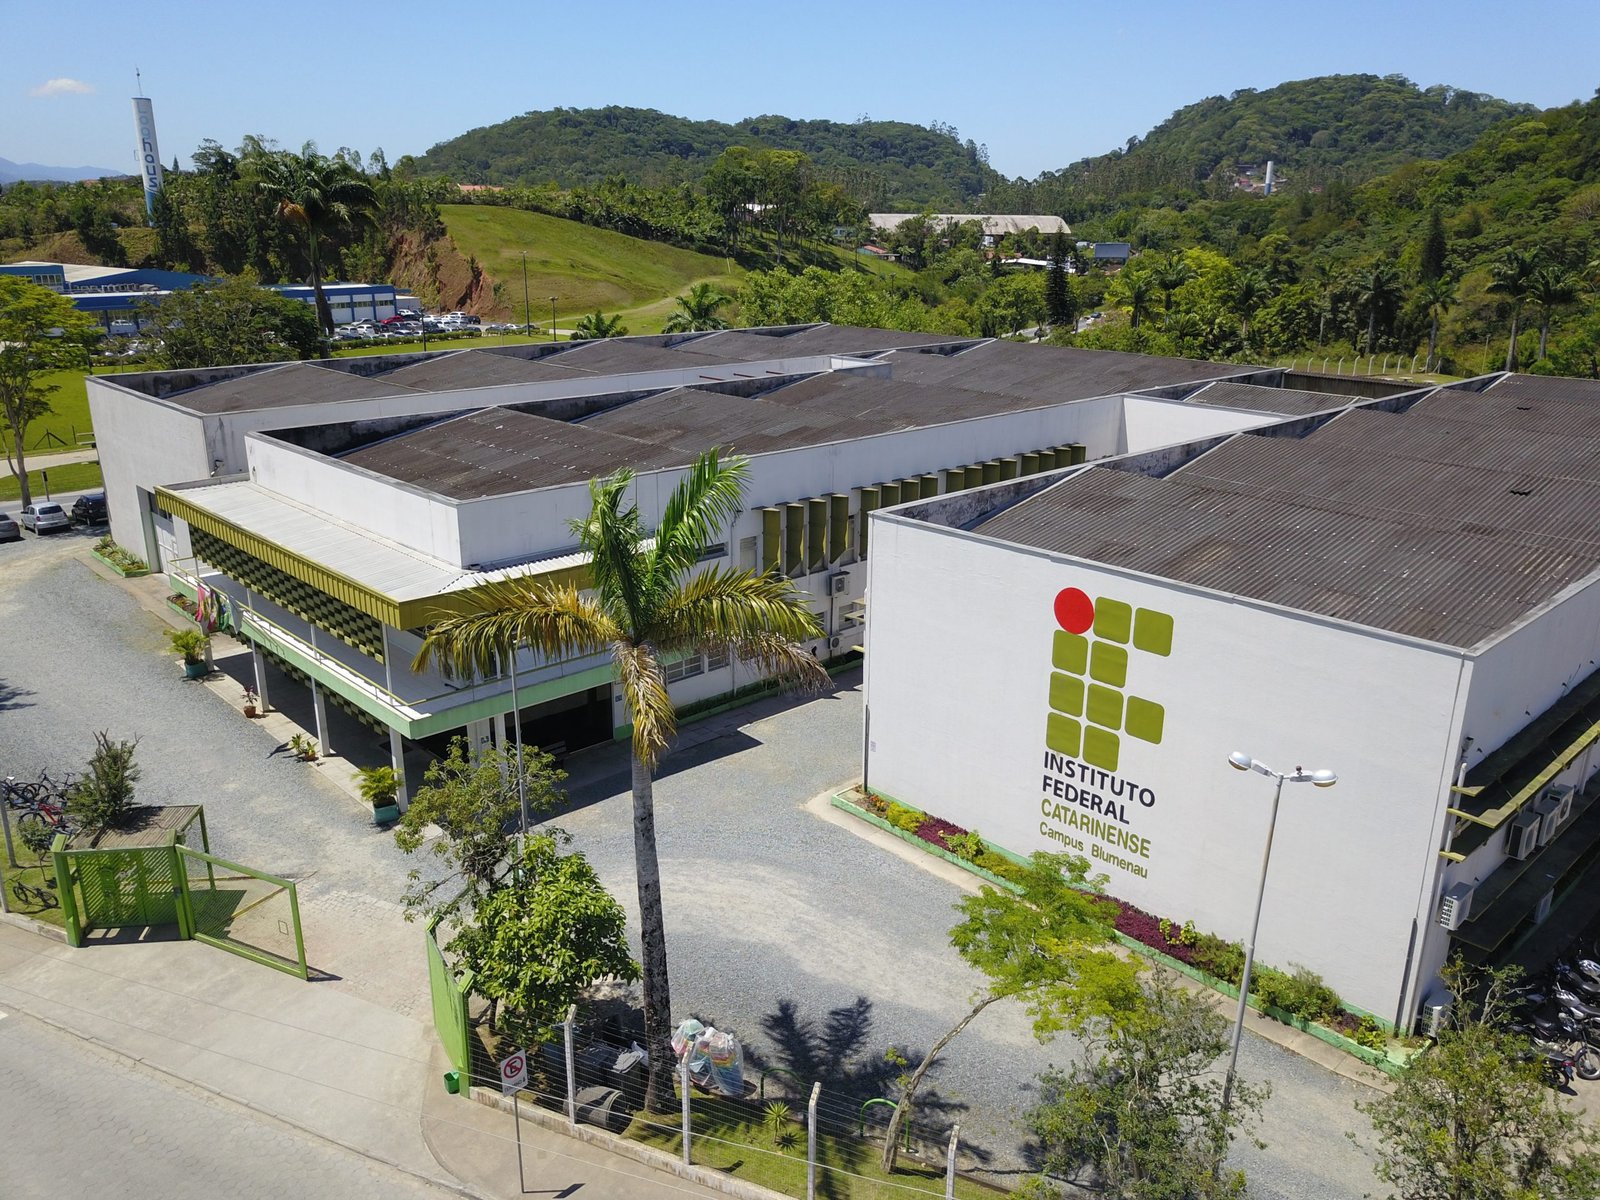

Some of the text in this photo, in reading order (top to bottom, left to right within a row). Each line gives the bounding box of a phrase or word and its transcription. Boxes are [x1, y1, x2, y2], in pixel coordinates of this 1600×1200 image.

[1042, 774, 1130, 825] FEDERAL
[1043, 750, 1156, 808] INSTITUTO
[1039, 821, 1148, 879] Campus Blumenau
[1041, 798, 1152, 859] CATARINENSE
